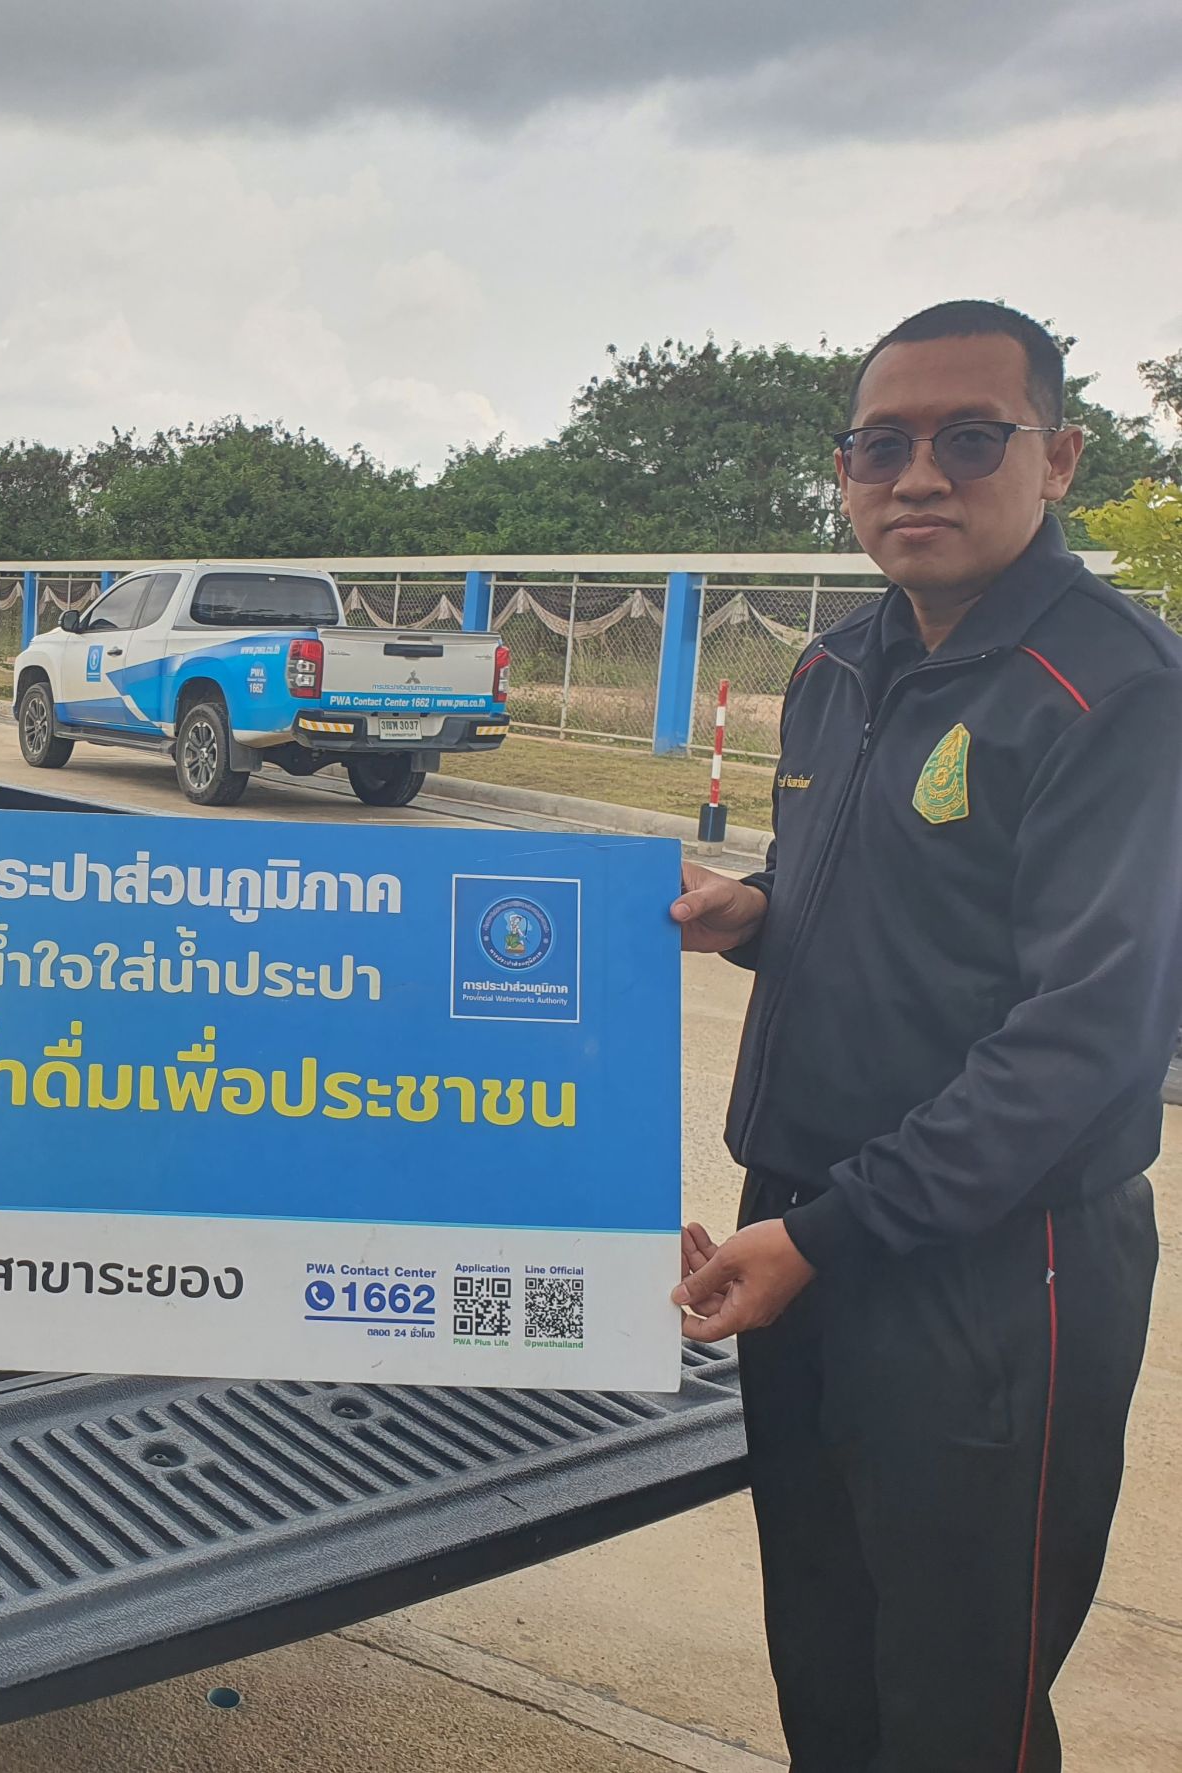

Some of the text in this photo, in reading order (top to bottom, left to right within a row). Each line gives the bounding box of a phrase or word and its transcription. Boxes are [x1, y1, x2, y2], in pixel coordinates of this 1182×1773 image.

[249, 683, 263, 693] 1662
[330, 696, 351, 706] PWA
[353, 697, 382, 706] Contact
[384, 697, 409, 707] Center
[411, 698, 430, 707] 1662
[436, 698, 486, 709] www.pwa.co.th
[399, 720, 419, 730] 3037
[462, 980, 569, 996] การประปาส่วนภูมิภาค
[462, 993, 568, 1006] Provincial Waterworks Authority
[306, 1263, 437, 1279] PWA Contact Center
[455, 1263, 510, 1274] Application
[524, 1265, 584, 1276] Line Official
[341, 1281, 436, 1315] 1662
[394, 1329, 407, 1337] 24
[453, 1338, 472, 1346] PWA
[474, 1339, 492, 1347] Plus
[524, 1340, 584, 1349] @pwathailand
